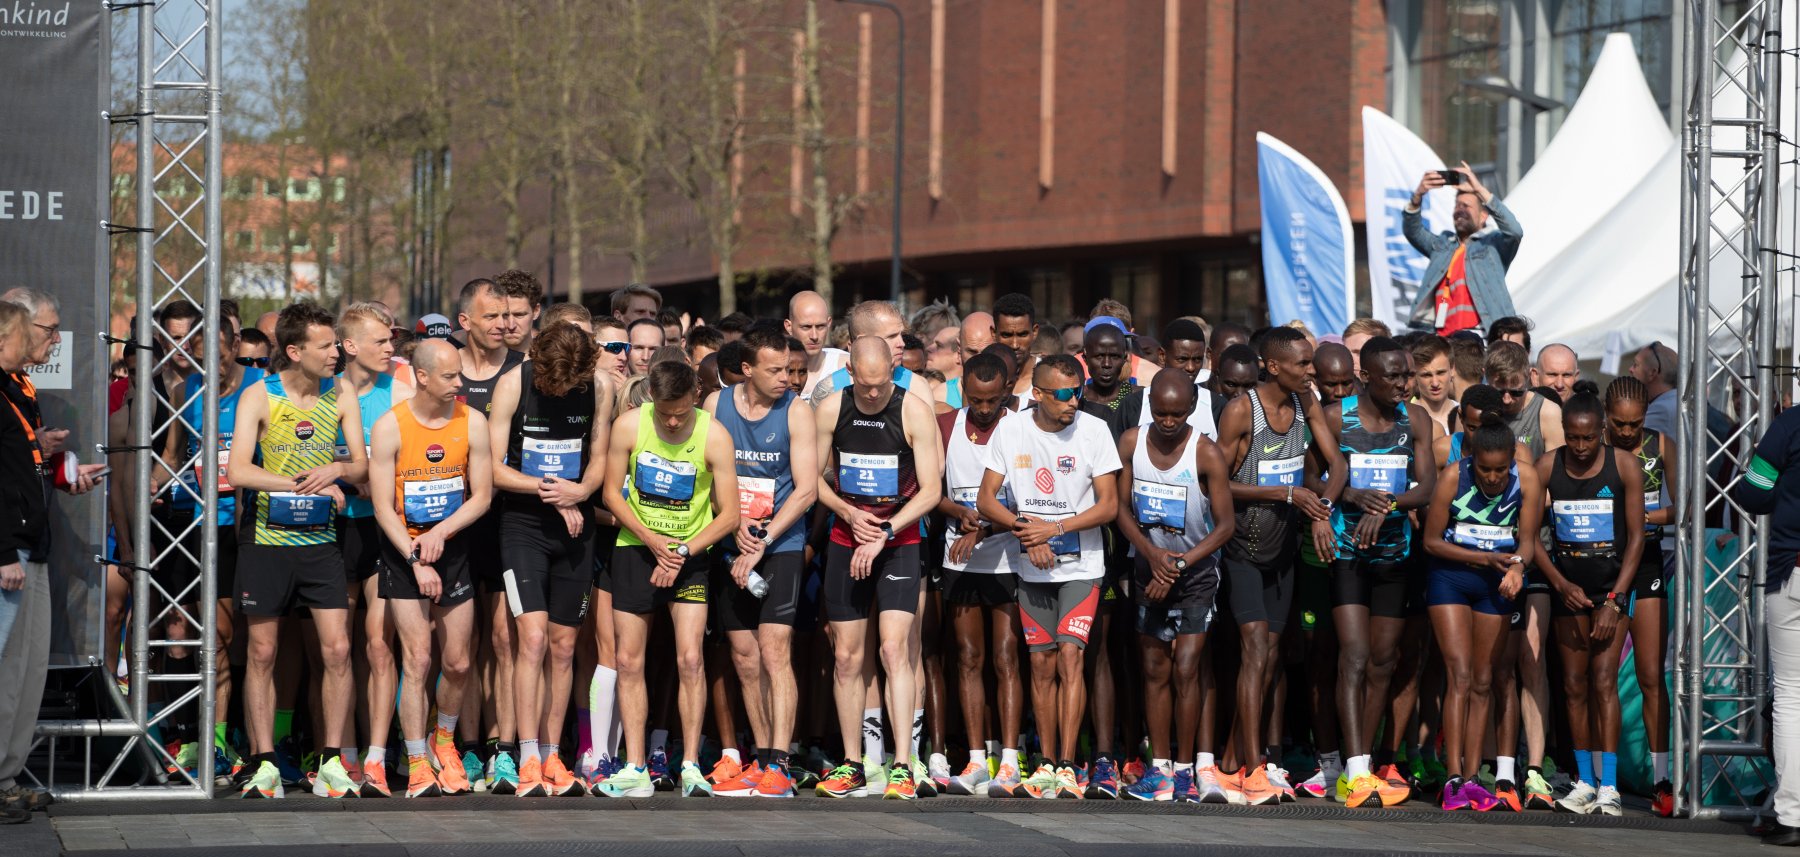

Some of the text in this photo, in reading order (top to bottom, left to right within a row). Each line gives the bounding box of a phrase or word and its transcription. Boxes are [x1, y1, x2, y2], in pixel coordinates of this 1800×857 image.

[0, 30, 67, 39] ONTWIKKELING
[0, 190, 64, 220] EDE
[428, 325, 452, 336] ciele
[852, 419, 886, 429] saucony
[270, 444, 292, 453] VAN
[544, 454, 561, 465] 43
[400, 468, 422, 478] VAN
[655, 471, 673, 484] 88
[859, 469, 875, 480] 21
[1373, 469, 1388, 481] 11
[1280, 473, 1294, 485] 40
[429, 483, 454, 491] DEMCON
[1150, 487, 1174, 496] DEMCON
[289, 499, 314, 510] 102
[424, 495, 448, 508] 116
[1025, 499, 1068, 509] SUPERGAUSS
[1148, 498, 1163, 510] 41
[1573, 516, 1590, 526] 35
